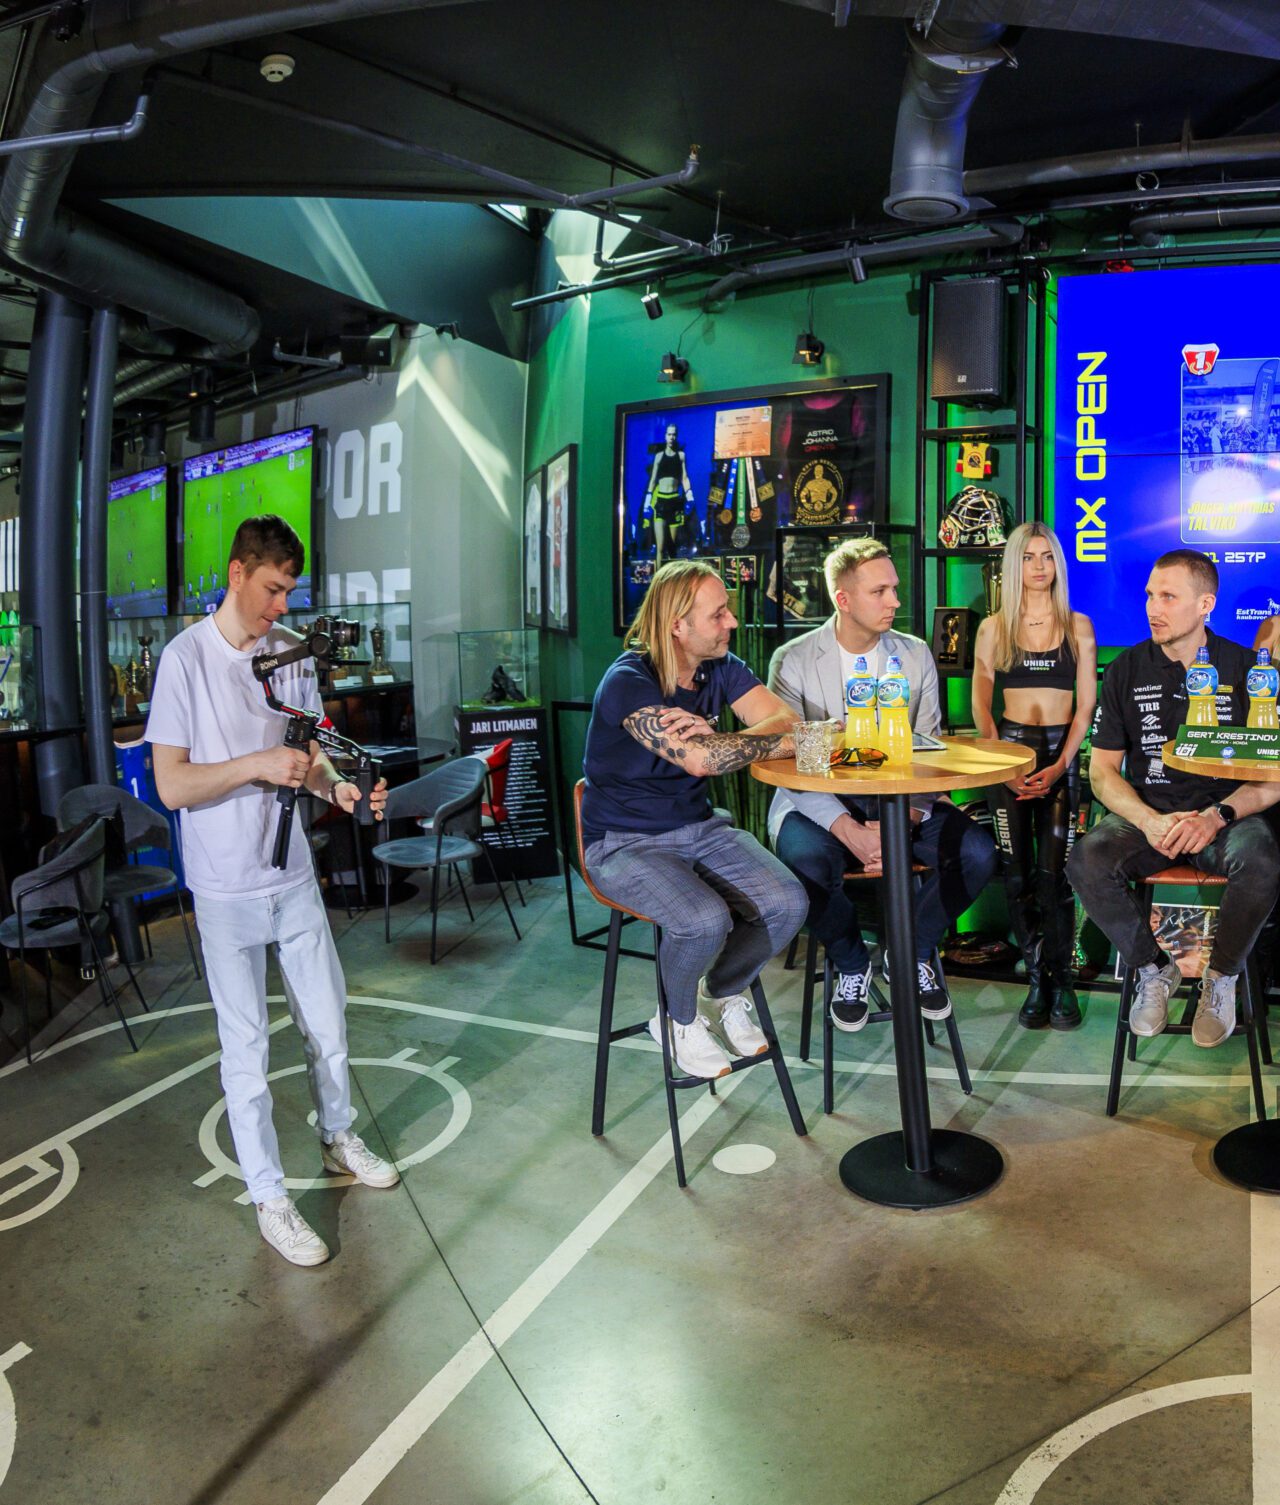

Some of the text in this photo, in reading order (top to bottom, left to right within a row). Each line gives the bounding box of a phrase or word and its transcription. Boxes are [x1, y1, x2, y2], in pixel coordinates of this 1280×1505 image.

[1195, 351, 1206, 369] 1
[807, 429, 834, 437] ASTRID
[802, 435, 839, 445] JOHANNA
[1076, 351, 1108, 563] MX OPEN
[1224, 552, 1266, 563] 257P
[1236, 608, 1272, 616] EstTrans
[260, 658, 279, 670] RONIN
[1138, 702, 1160, 713] TRB
[470, 719, 537, 733] JARI LITMANEN
[1187, 731, 1278, 741] GERT KRESTINOV
[996, 808, 1013, 855] UNIBET
